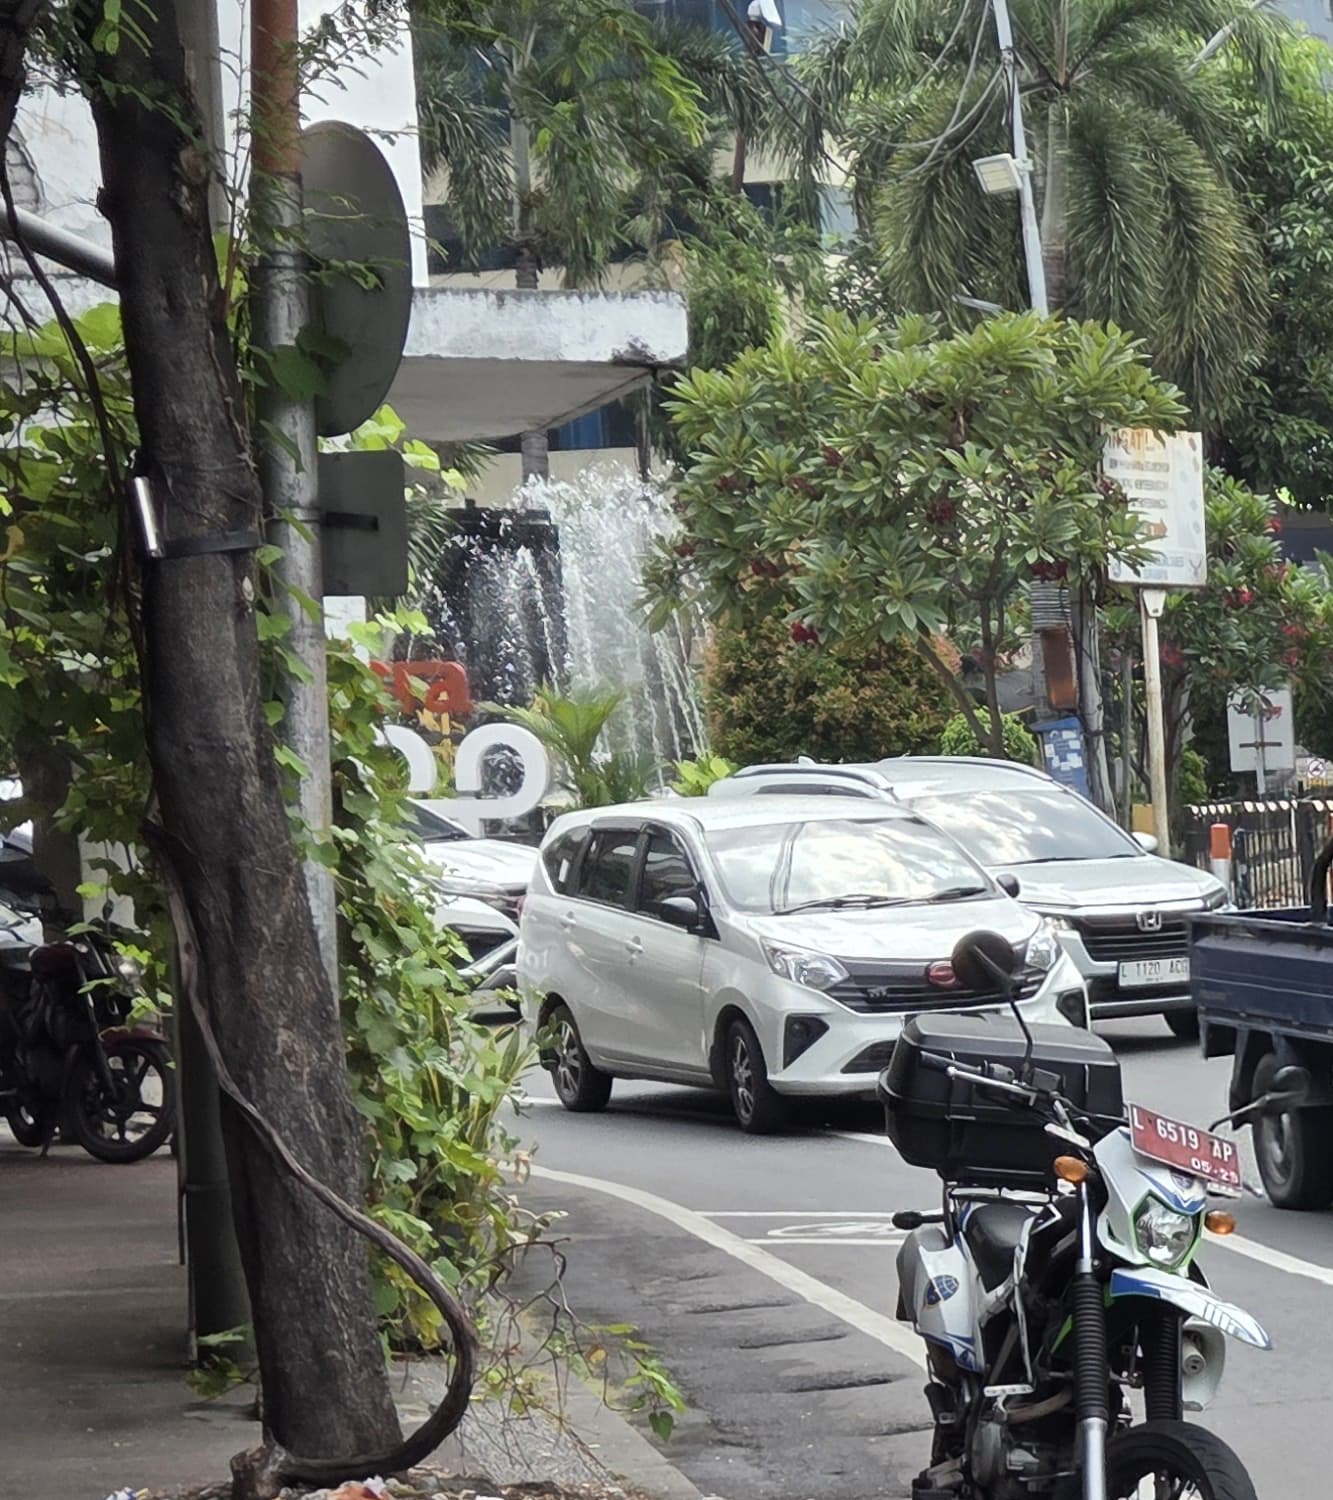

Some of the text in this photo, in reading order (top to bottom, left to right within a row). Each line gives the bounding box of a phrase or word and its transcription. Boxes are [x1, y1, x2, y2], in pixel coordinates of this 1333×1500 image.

[1133, 1107, 1233, 1162] L 6519 AP
